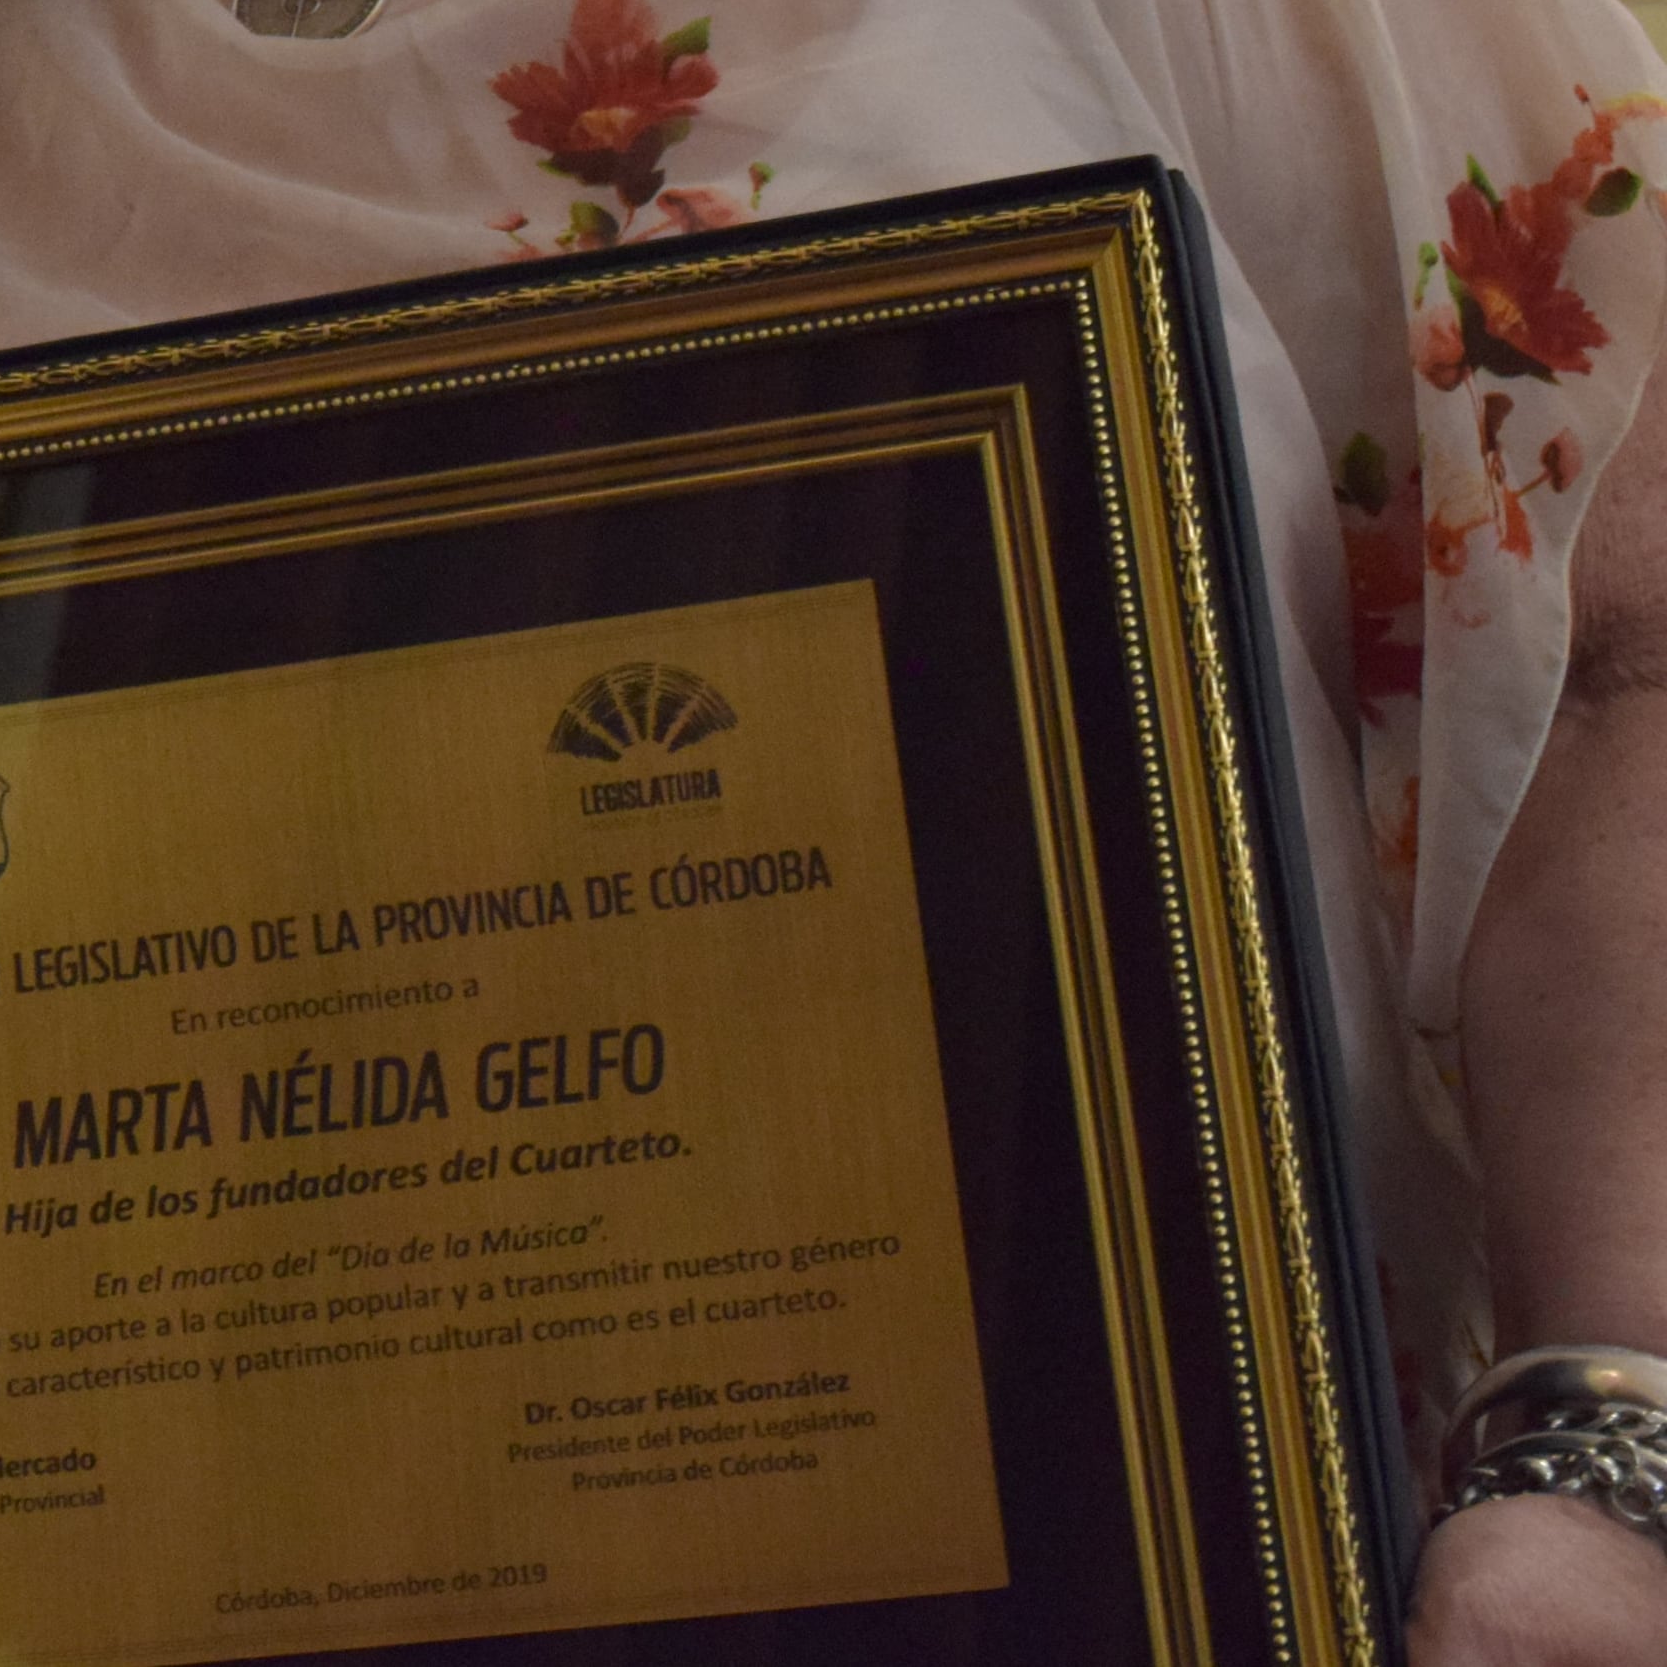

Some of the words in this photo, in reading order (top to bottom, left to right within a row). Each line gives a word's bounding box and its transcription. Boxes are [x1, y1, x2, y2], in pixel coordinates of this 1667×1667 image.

[579, 766, 722, 814] LEGISLATURA
[12, 923, 237, 994] LEGISLATIVO
[249, 914, 299, 964] DE
[311, 908, 361, 956] LA
[372, 879, 573, 947] PROVINCIA
[583, 870, 637, 920] DE
[648, 845, 833, 910] CÓRDOBA
[169, 1006, 208, 1035] En
[214, 977, 454, 1029] reconocimiento
[461, 976, 479, 999] a
[13, 1077, 213, 1169] MARTA
[238, 1047, 449, 1142] NÉLIDA
[474, 1022, 664, 1114] GELFO
[3, 1196, 78, 1238] Hija
[88, 1189, 136, 1226] de
[145, 1184, 198, 1218] los
[205, 1161, 428, 1220] fundadores
[438, 1144, 499, 1185] del
[508, 1129, 693, 1176] Cuarteto.
[7, 1330, 42, 1354] su
[49, 1316, 147, 1352] aporte
[154, 1315, 172, 1337] a
[179, 1306, 206, 1335] la
[213, 1298, 318, 1331] cultura
[325, 1281, 443, 1324] popular
[450, 1282, 469, 1311] y
[476, 1279, 495, 1302] a
[501, 1257, 653, 1299] transmitir
[661, 1247, 783, 1281] nuestro
[788, 1234, 901, 1274] género
[93, 1270, 128, 1300] En
[136, 1264, 163, 1295] el
[170, 1259, 264, 1291] marco
[271, 1247, 318, 1280] del
[394, 1234, 435, 1265] de
[443, 1231, 472, 1259] la
[5, 1355, 201, 1399] característico
[208, 1355, 226, 1383] y
[233, 1333, 400, 1381] patrimonio
[408, 1316, 523, 1355] cultural
[529, 1312, 619, 1344] como
[624, 1308, 661, 1332] es
[667, 1296, 696, 1329] el
[703, 1287, 847, 1324] cuarteto.
[523, 1400, 563, 1426] Dr.
[568, 1394, 647, 1421] Oscar
[653, 1383, 719, 1412] Félix
[722, 1369, 850, 1404] González
[505, 1434, 630, 1464] Presidente
[636, 1425, 674, 1451] del
[676, 1419, 748, 1446] Poder
[751, 1407, 878, 1441] Legislativo
[569, 1462, 679, 1493] Provincia
[680, 1458, 714, 1482] de
[717, 1447, 819, 1478] Córdoba
[213, 1586, 321, 1615] Córdoba,
[326, 1574, 446, 1603] Diciembre
[450, 1569, 482, 1592] de
[487, 1562, 547, 1589] 2019
